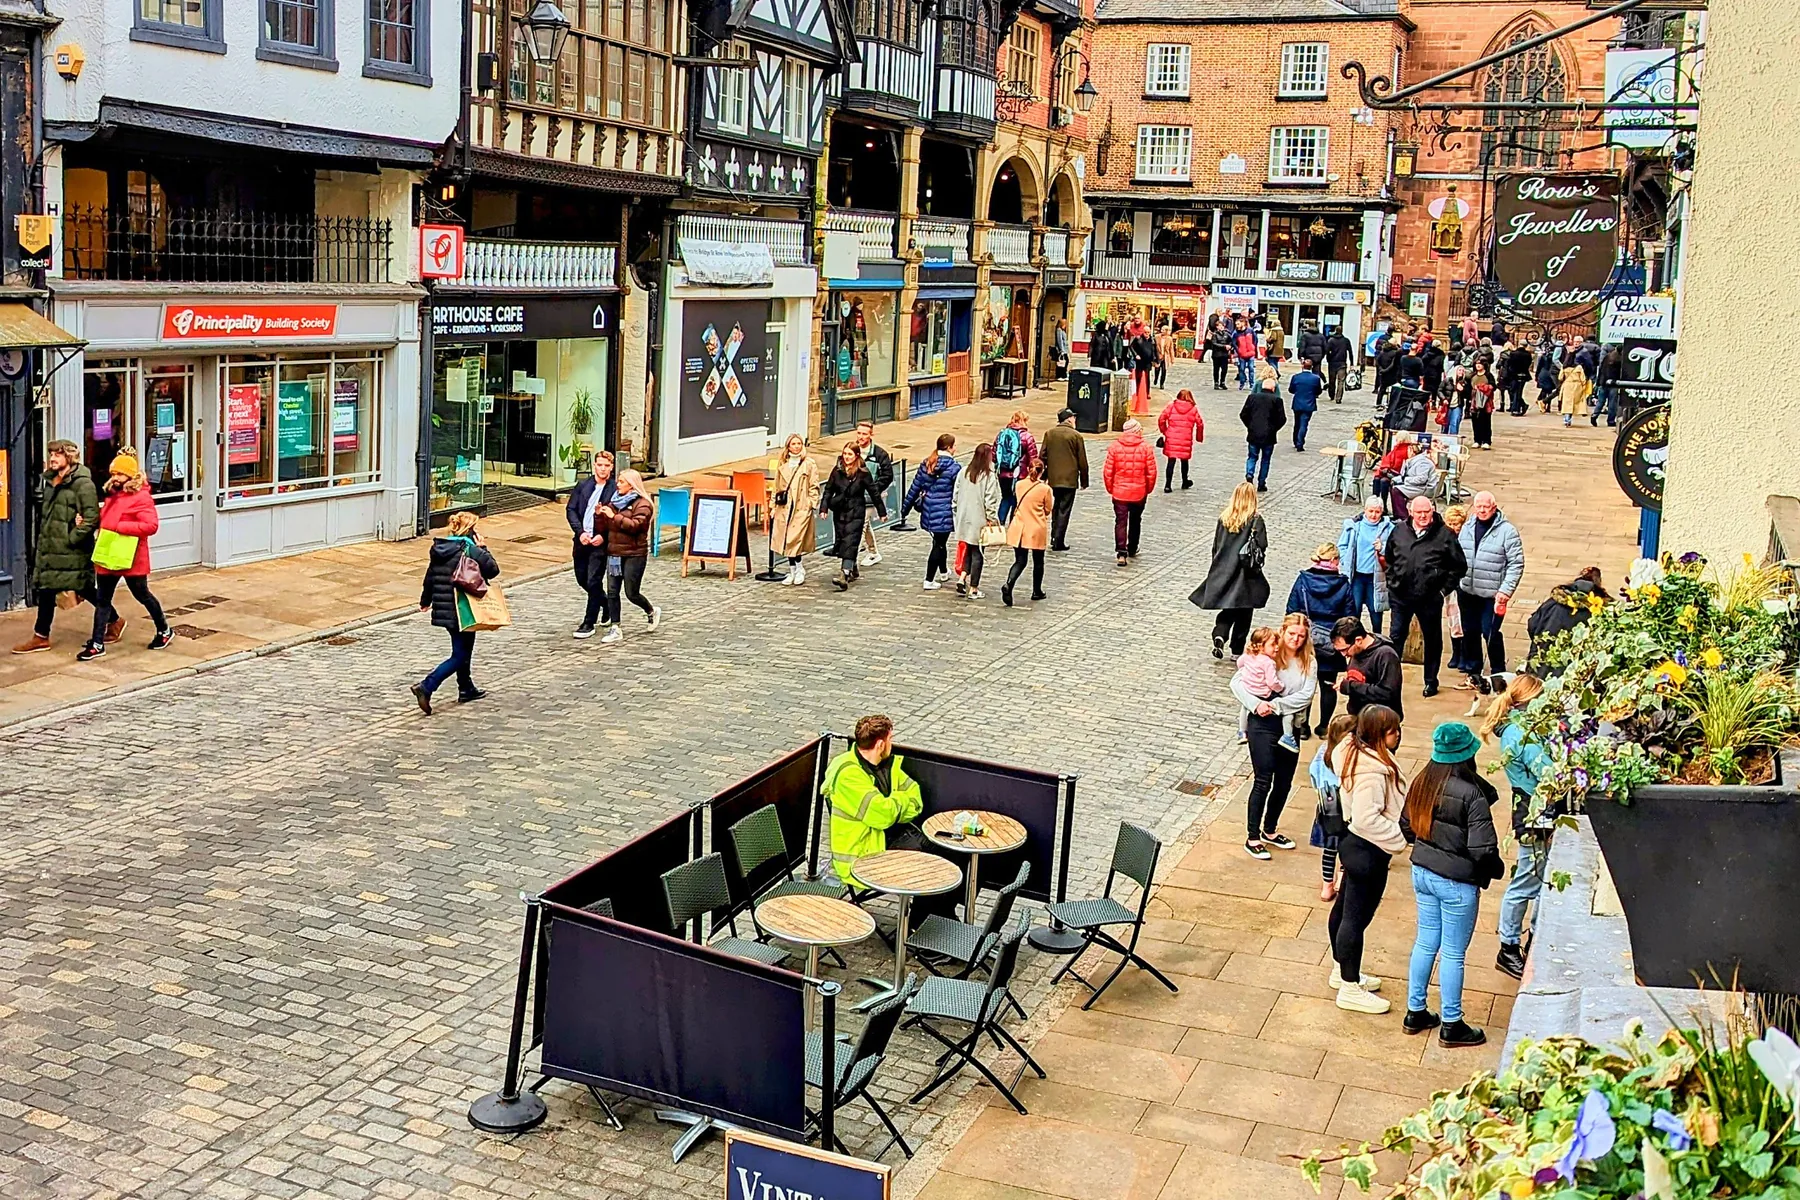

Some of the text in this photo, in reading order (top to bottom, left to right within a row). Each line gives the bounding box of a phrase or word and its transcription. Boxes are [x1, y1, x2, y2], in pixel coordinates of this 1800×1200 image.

[1518, 177, 1600, 200] Row's
[1498, 208, 1618, 245] Jewellers
[1547, 245, 1581, 278] of
[1083, 280, 1134, 291] TIMPSON
[1238, 286, 1253, 294] LET
[1262, 288, 1336, 300] TechRestore
[1517, 281, 1600, 306] Chester
[433, 306, 524, 323] ARTHOUSE CAFE
[1616, 302, 1660, 313] ays
[194, 314, 331, 333] Principality Building Society
[452, 324, 487, 334] EXHIBITIONS
[490, 323, 523, 333] WORKSHOPS
[1610, 314, 1664, 328] Travel
[743, 364, 756, 372] 2023
[1624, 431, 1644, 457] THE
